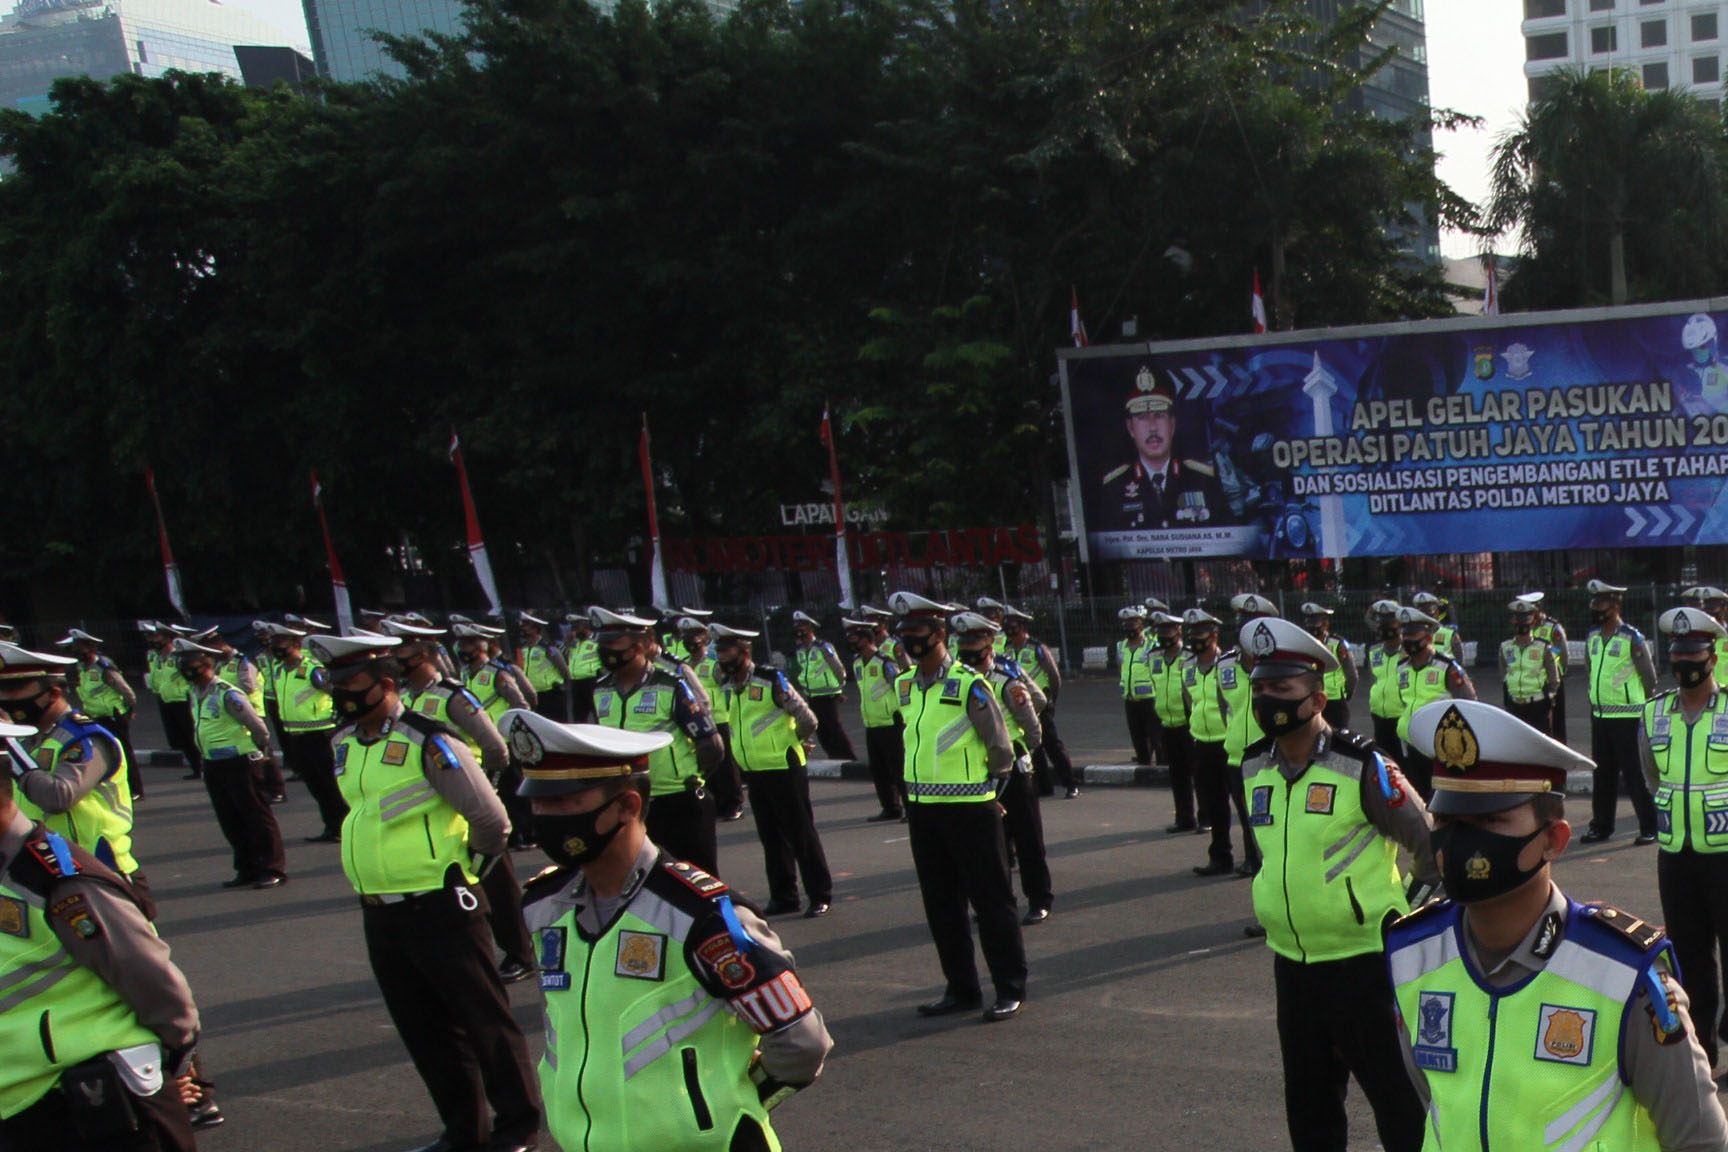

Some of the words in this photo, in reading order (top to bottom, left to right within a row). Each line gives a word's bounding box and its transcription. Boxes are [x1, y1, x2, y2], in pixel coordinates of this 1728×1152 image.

[1352, 398, 1422, 430] APEL
[1427, 391, 1521, 426] GELAR
[1527, 382, 1671, 419] PASUKAN
[1272, 437, 1388, 468] OPERASI
[1394, 429, 1489, 461] PATUH
[1495, 425, 1576, 457] JAYA
[1580, 418, 1686, 452] TAHUN
[1293, 475, 1330, 495] DAN
[1334, 469, 1443, 492] SOSIALISASI
[1446, 462, 1606, 488] PENGEMBANGAN
[1610, 458, 1660, 480] ETLE
[1371, 489, 1472, 514] DITLANTAS
[1475, 487, 1538, 509] POLDA
[1542, 484, 1610, 505] METRO
[1613, 481, 1670, 502] JAYA
[846, 525, 1045, 570] DITLANTAS
